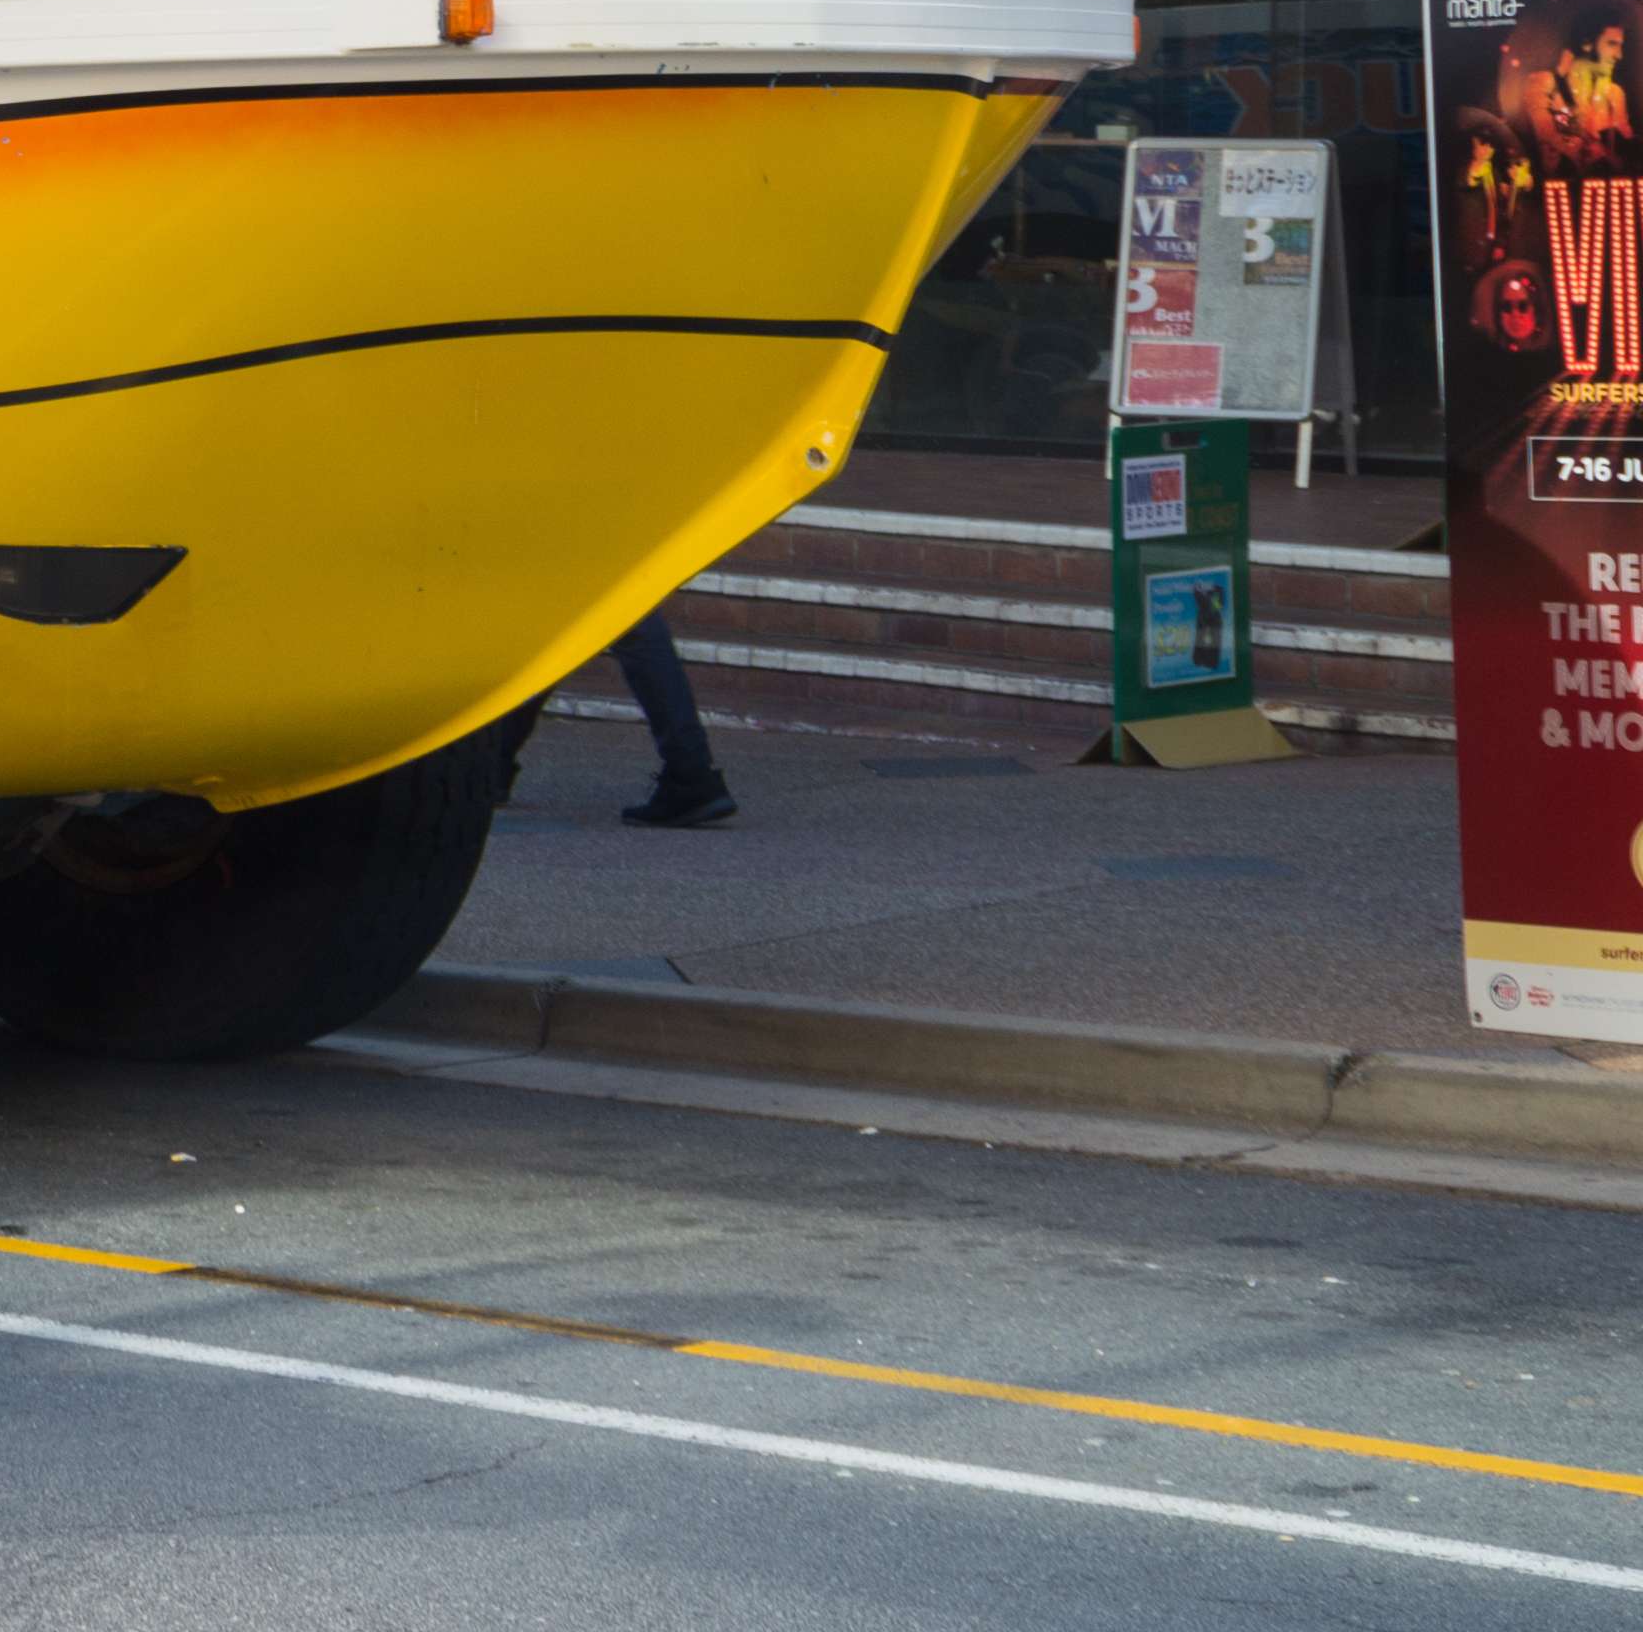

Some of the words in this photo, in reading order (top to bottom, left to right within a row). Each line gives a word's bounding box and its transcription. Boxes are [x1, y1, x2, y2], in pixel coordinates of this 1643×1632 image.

[1149, 174, 1190, 187] NTA
[1544, 179, 1643, 373] VI
[1153, 307, 1193, 323] Best
[1556, 456, 1613, 483] 7-16
[1587, 551, 1643, 594] RE
[1540, 601, 1622, 645] THE
[1540, 706, 1572, 749] &
[1600, 946, 1643, 962] surfe
